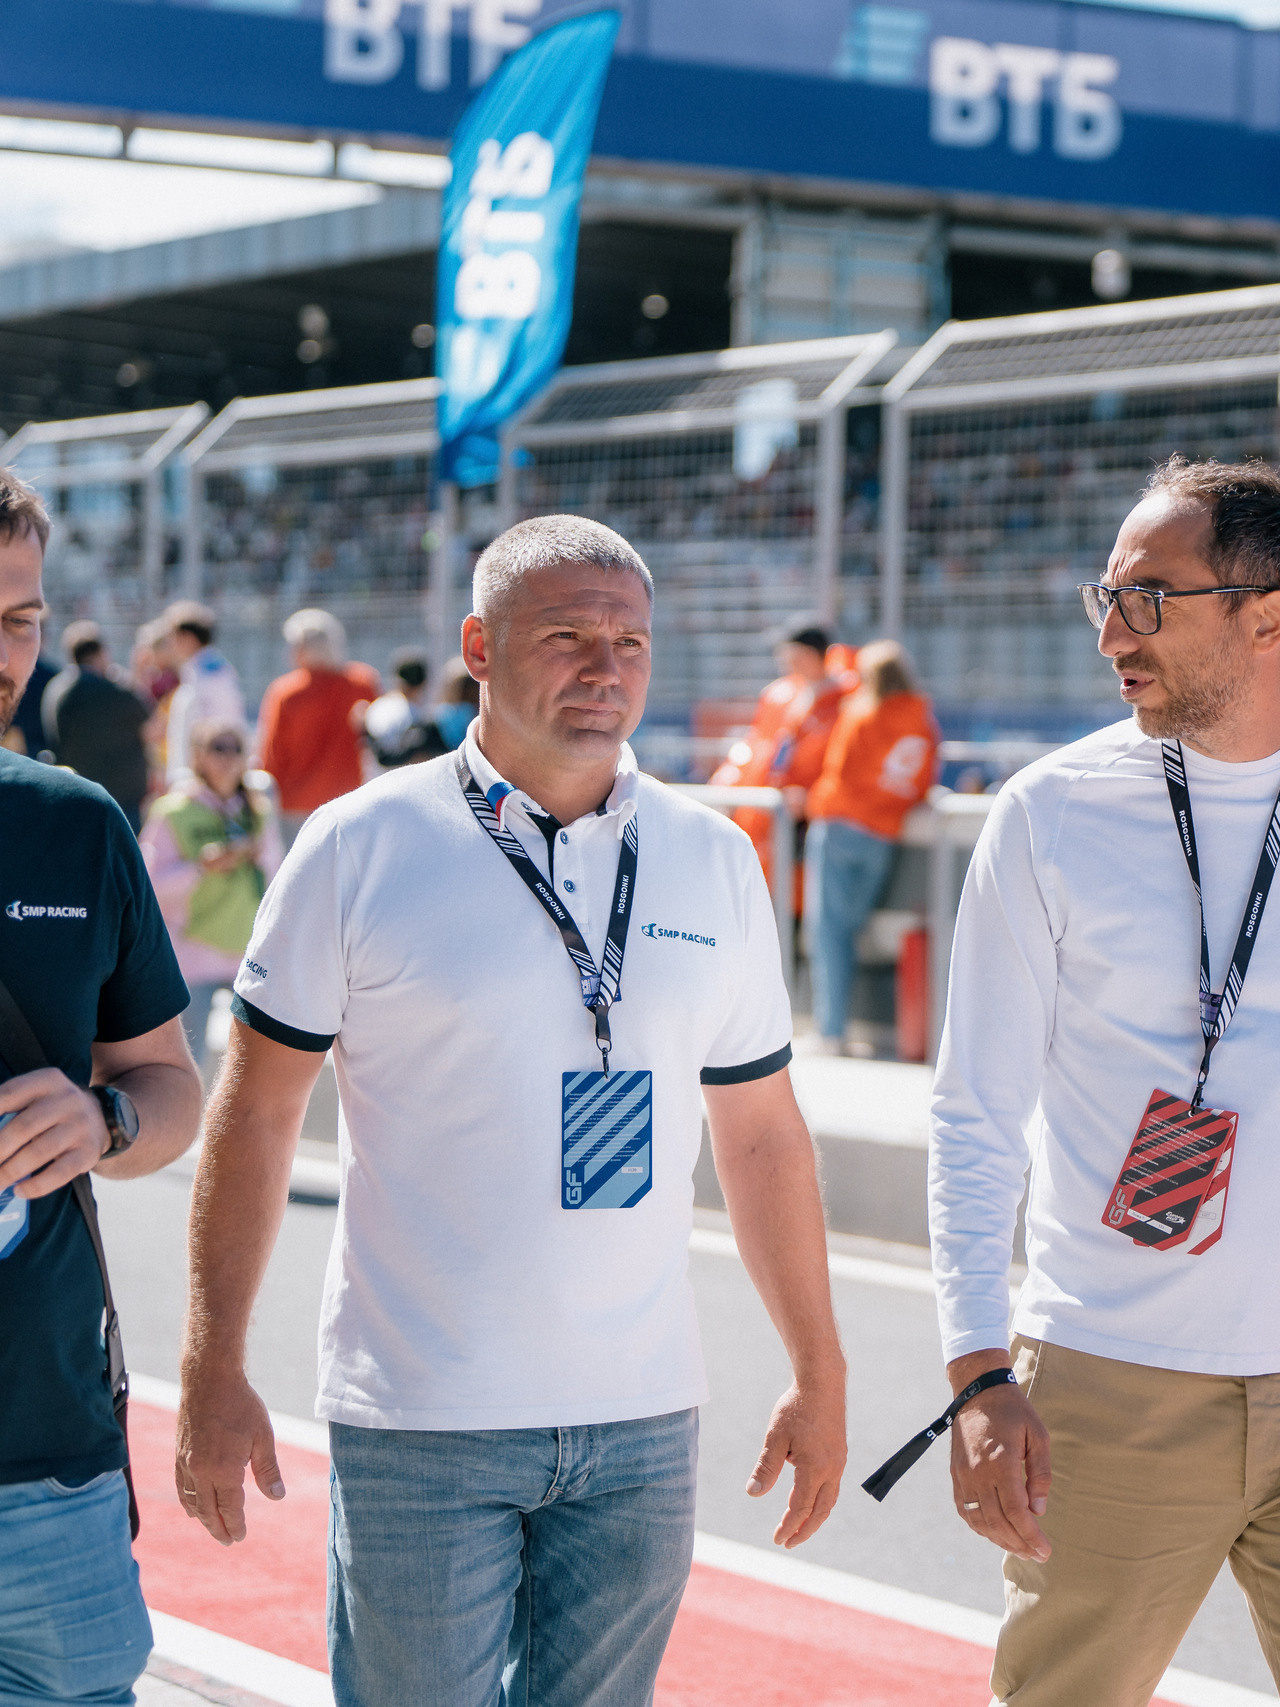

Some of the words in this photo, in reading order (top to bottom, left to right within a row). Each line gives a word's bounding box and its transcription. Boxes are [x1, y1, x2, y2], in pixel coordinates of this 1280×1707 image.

[929, 35, 1123, 161] ВТБ
[454, 131, 554, 319] ВТБ
[1179, 810, 1192, 857] ROSGONKI
[21, 905, 46, 917] SMP
[47, 906, 87, 919] RACING
[535, 882, 566, 920] ROSGONKI
[617, 874, 629, 914] ROSGONKI
[1245, 892, 1264, 938] ROSGONKI
[657, 928, 680, 939] SMP
[681, 932, 716, 947] RACING
[566, 1169, 582, 1205] GF
[1108, 1187, 1128, 1226] GF
